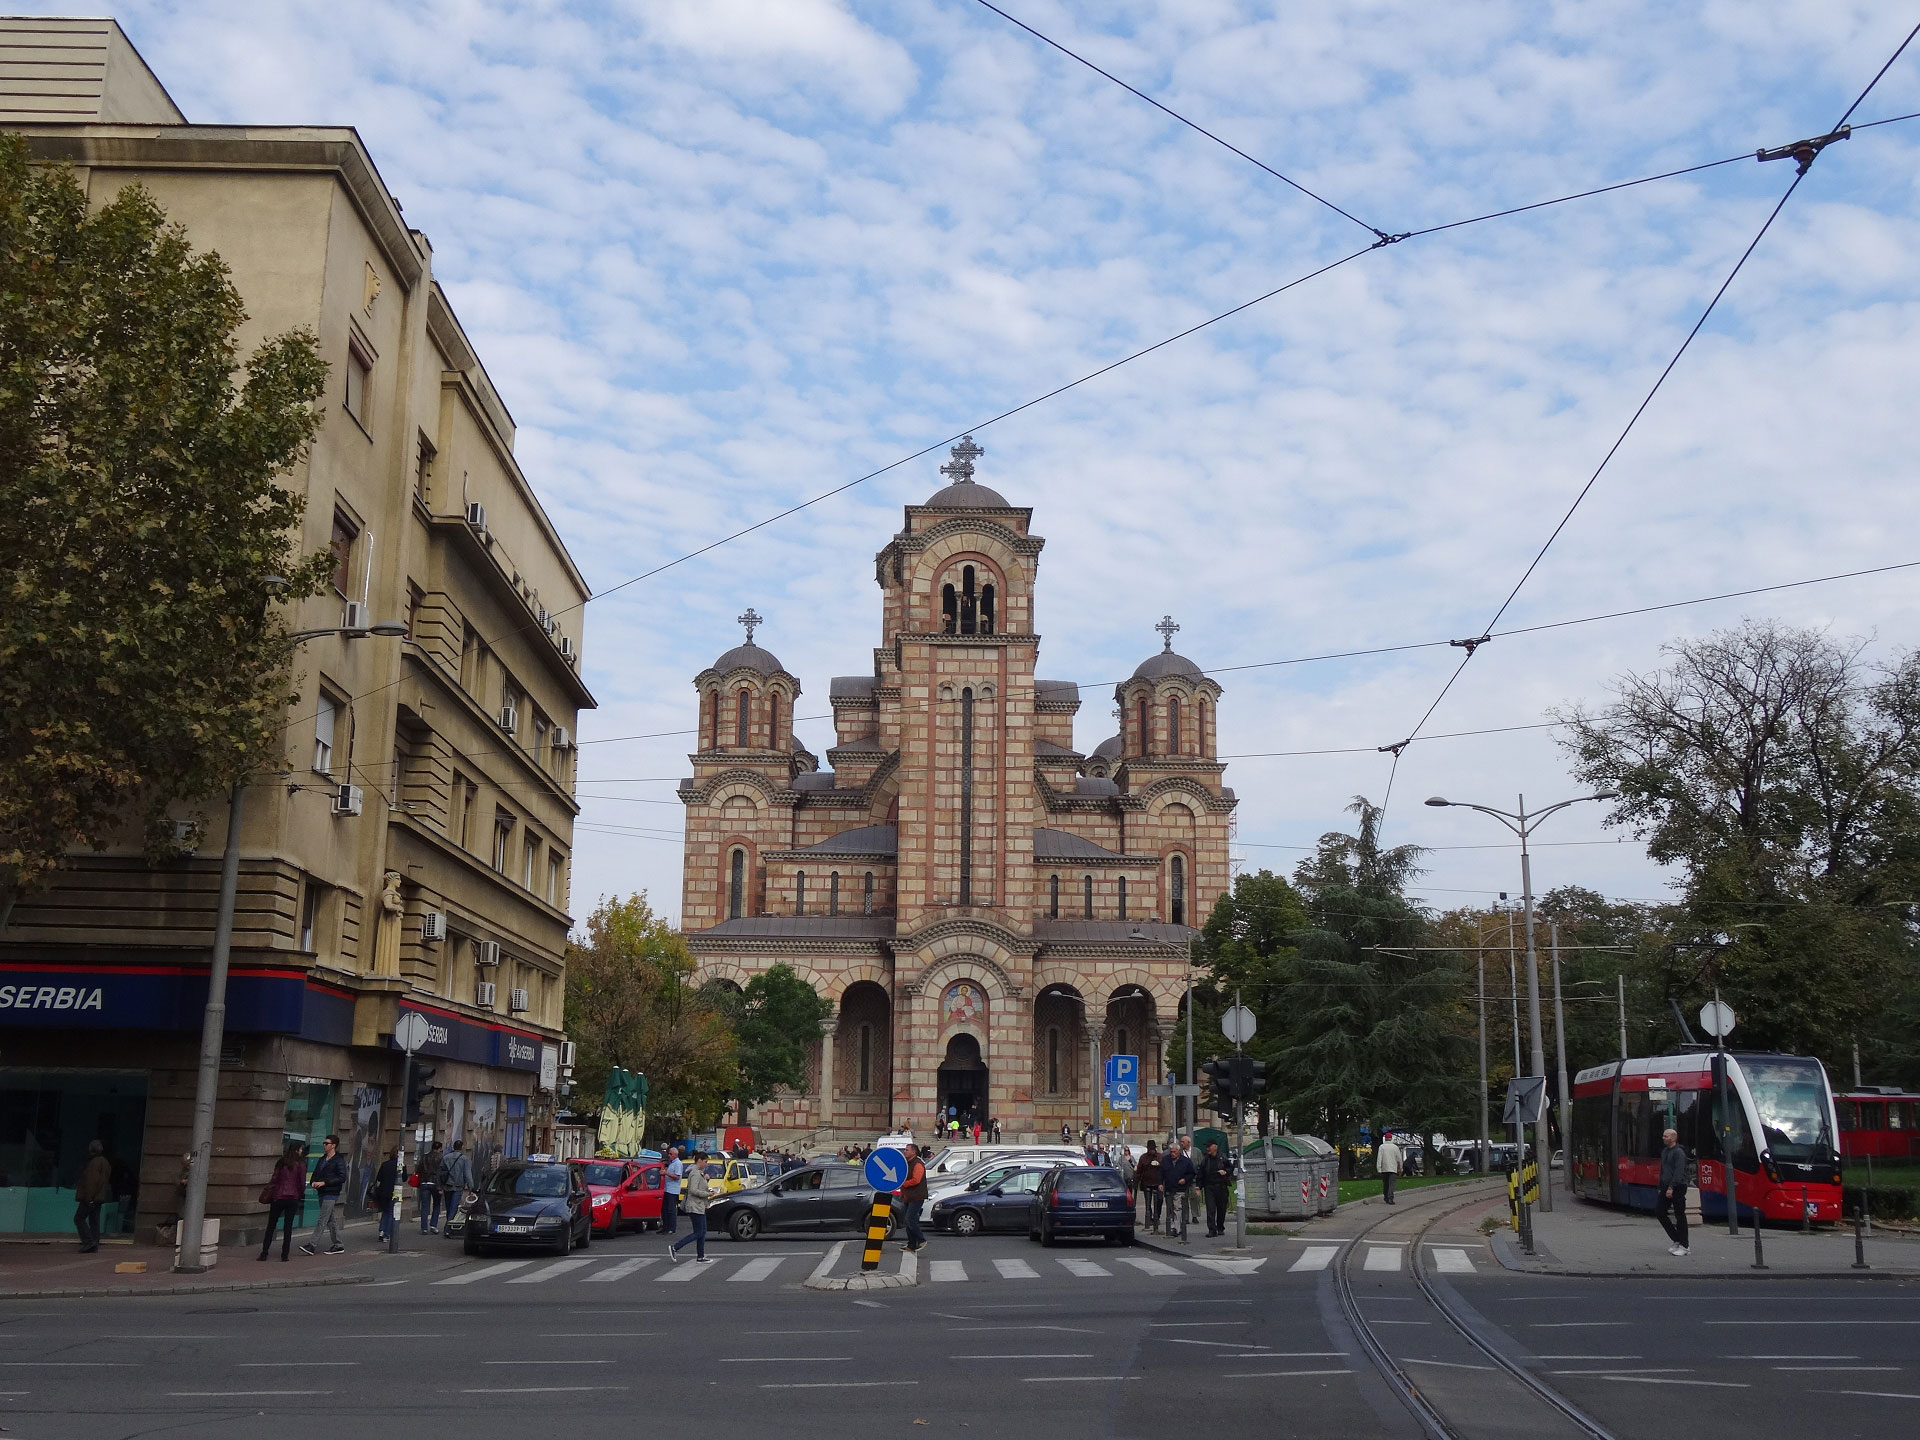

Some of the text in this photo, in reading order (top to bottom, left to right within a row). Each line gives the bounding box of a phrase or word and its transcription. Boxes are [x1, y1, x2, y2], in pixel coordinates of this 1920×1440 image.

[0, 986, 102, 1010] SERBIA
[428, 1025, 448, 1044] SERBIA
[1117, 1059, 1132, 1079] P
